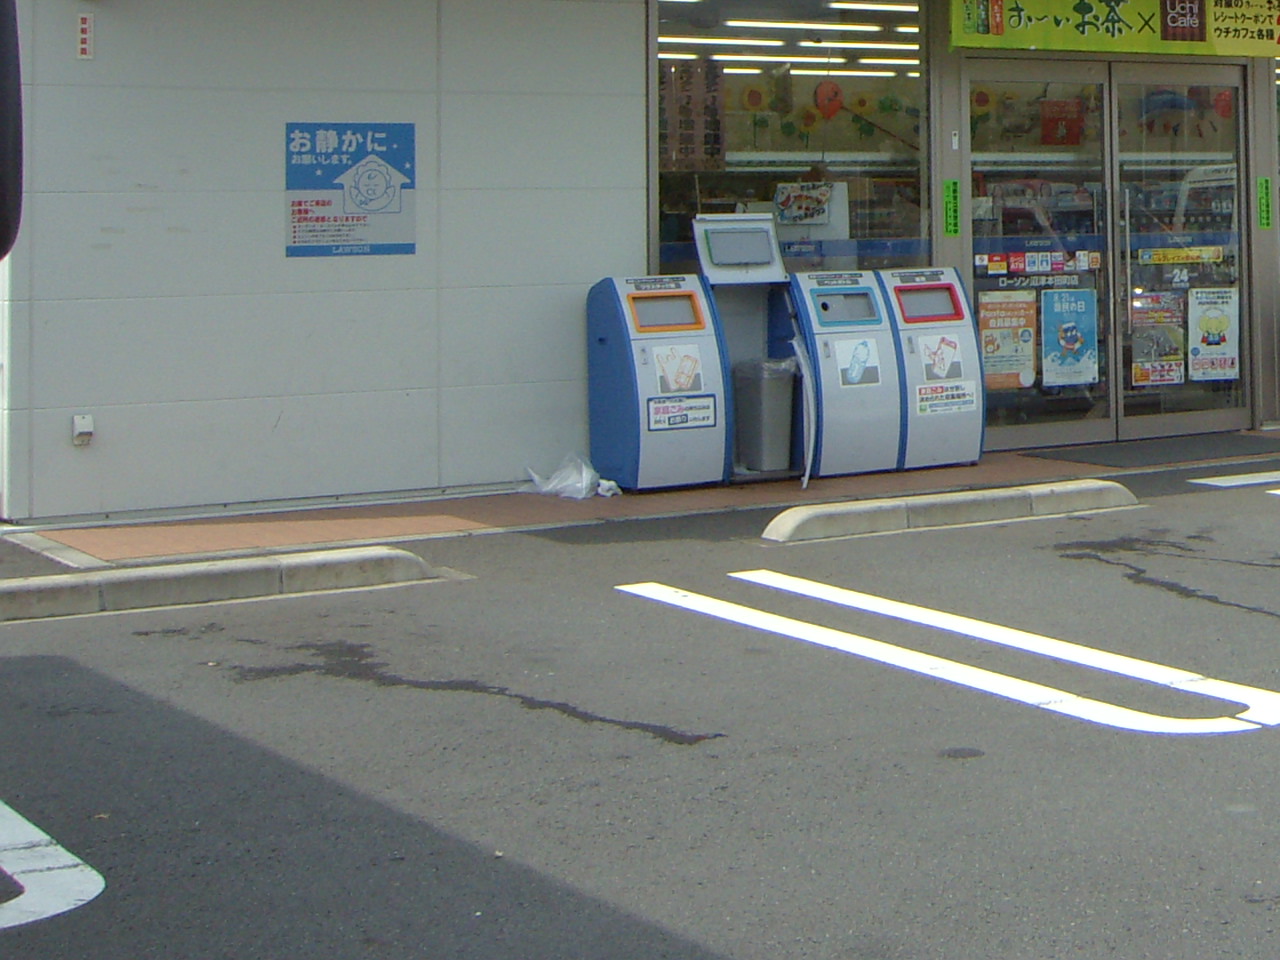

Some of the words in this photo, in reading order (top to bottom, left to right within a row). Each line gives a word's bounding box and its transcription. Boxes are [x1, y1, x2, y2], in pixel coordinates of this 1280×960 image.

[1166, 0, 1199, 15] Uchi
[1167, 13, 1200, 28] Café
[1213, 11, 1275, 26] レシートクーポンで
[1213, 26, 1275, 41] ウチカフェ各種
[289, 129, 388, 154] お静かに
[1171, 268, 1190, 283] 24
